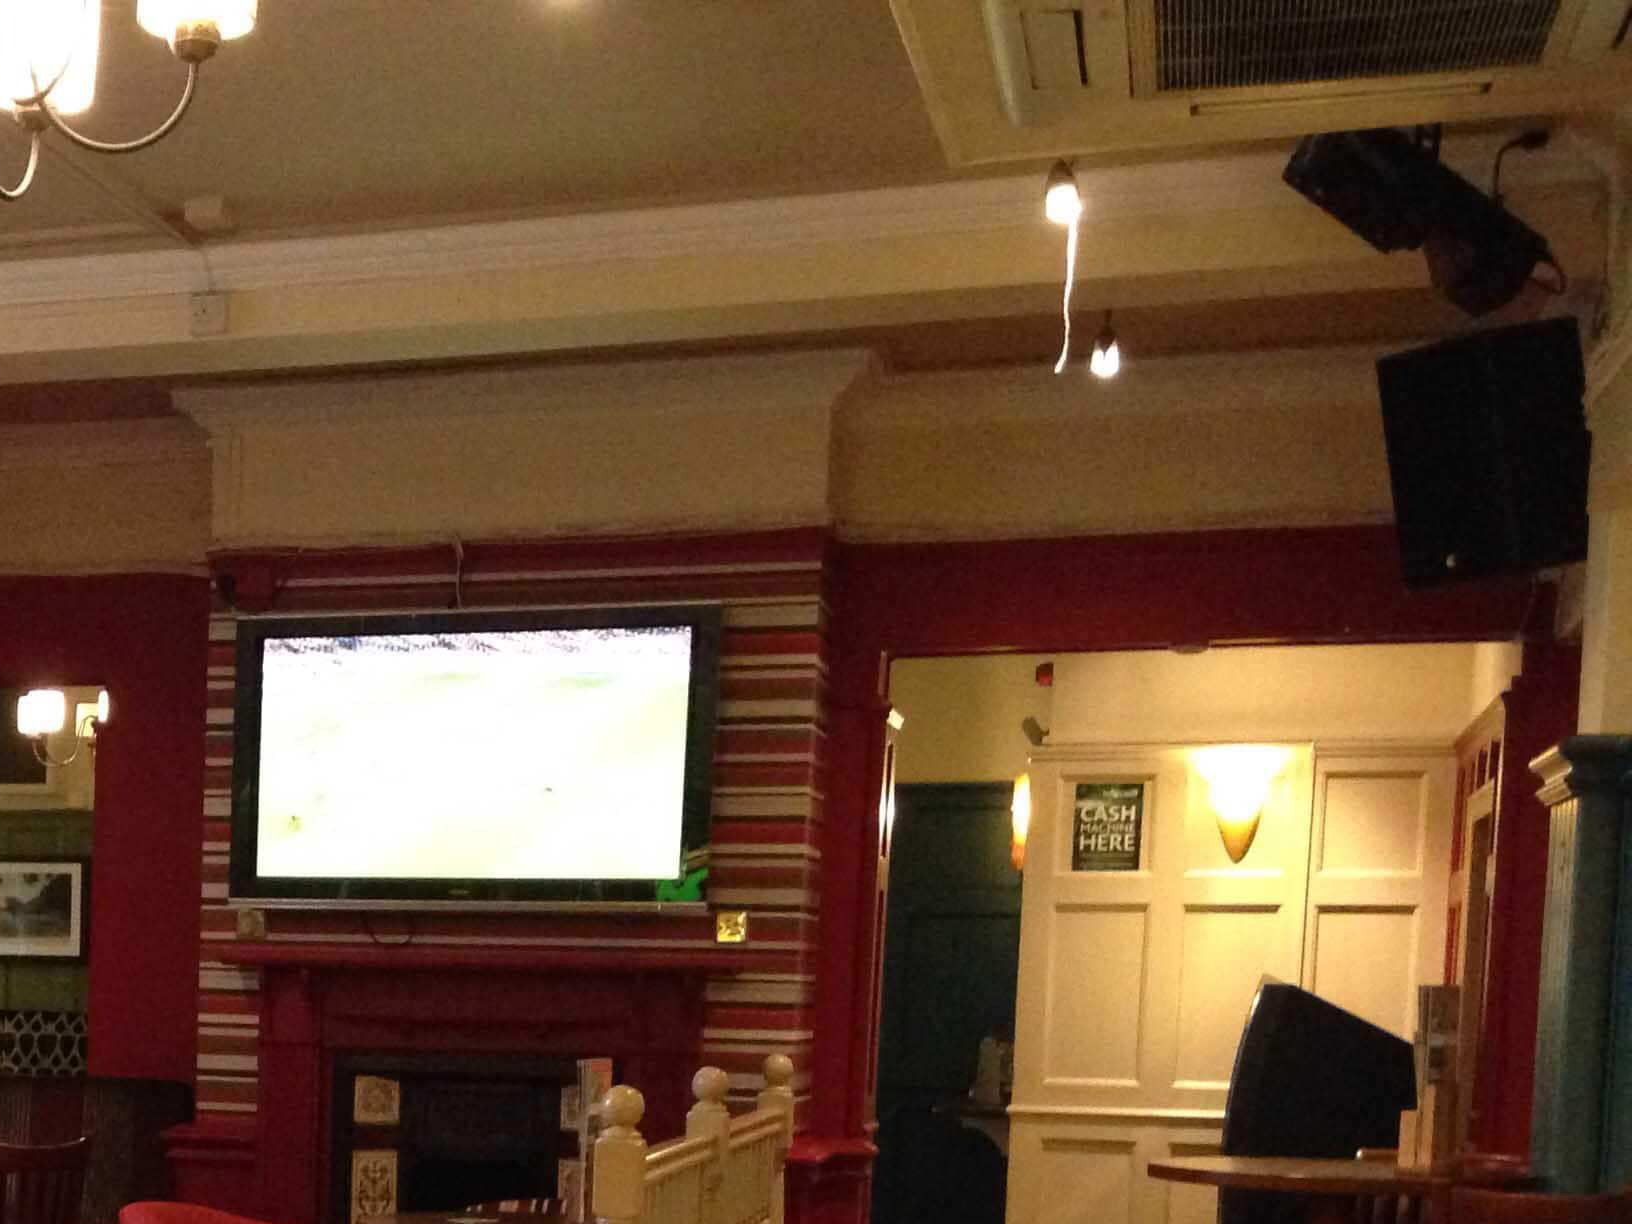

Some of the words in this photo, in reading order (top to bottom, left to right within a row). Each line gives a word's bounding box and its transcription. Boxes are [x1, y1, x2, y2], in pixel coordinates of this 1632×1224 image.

[1079, 805, 1137, 822] CASH
[1079, 822, 1136, 833] MACHINE
[1078, 834, 1136, 851] HERE
